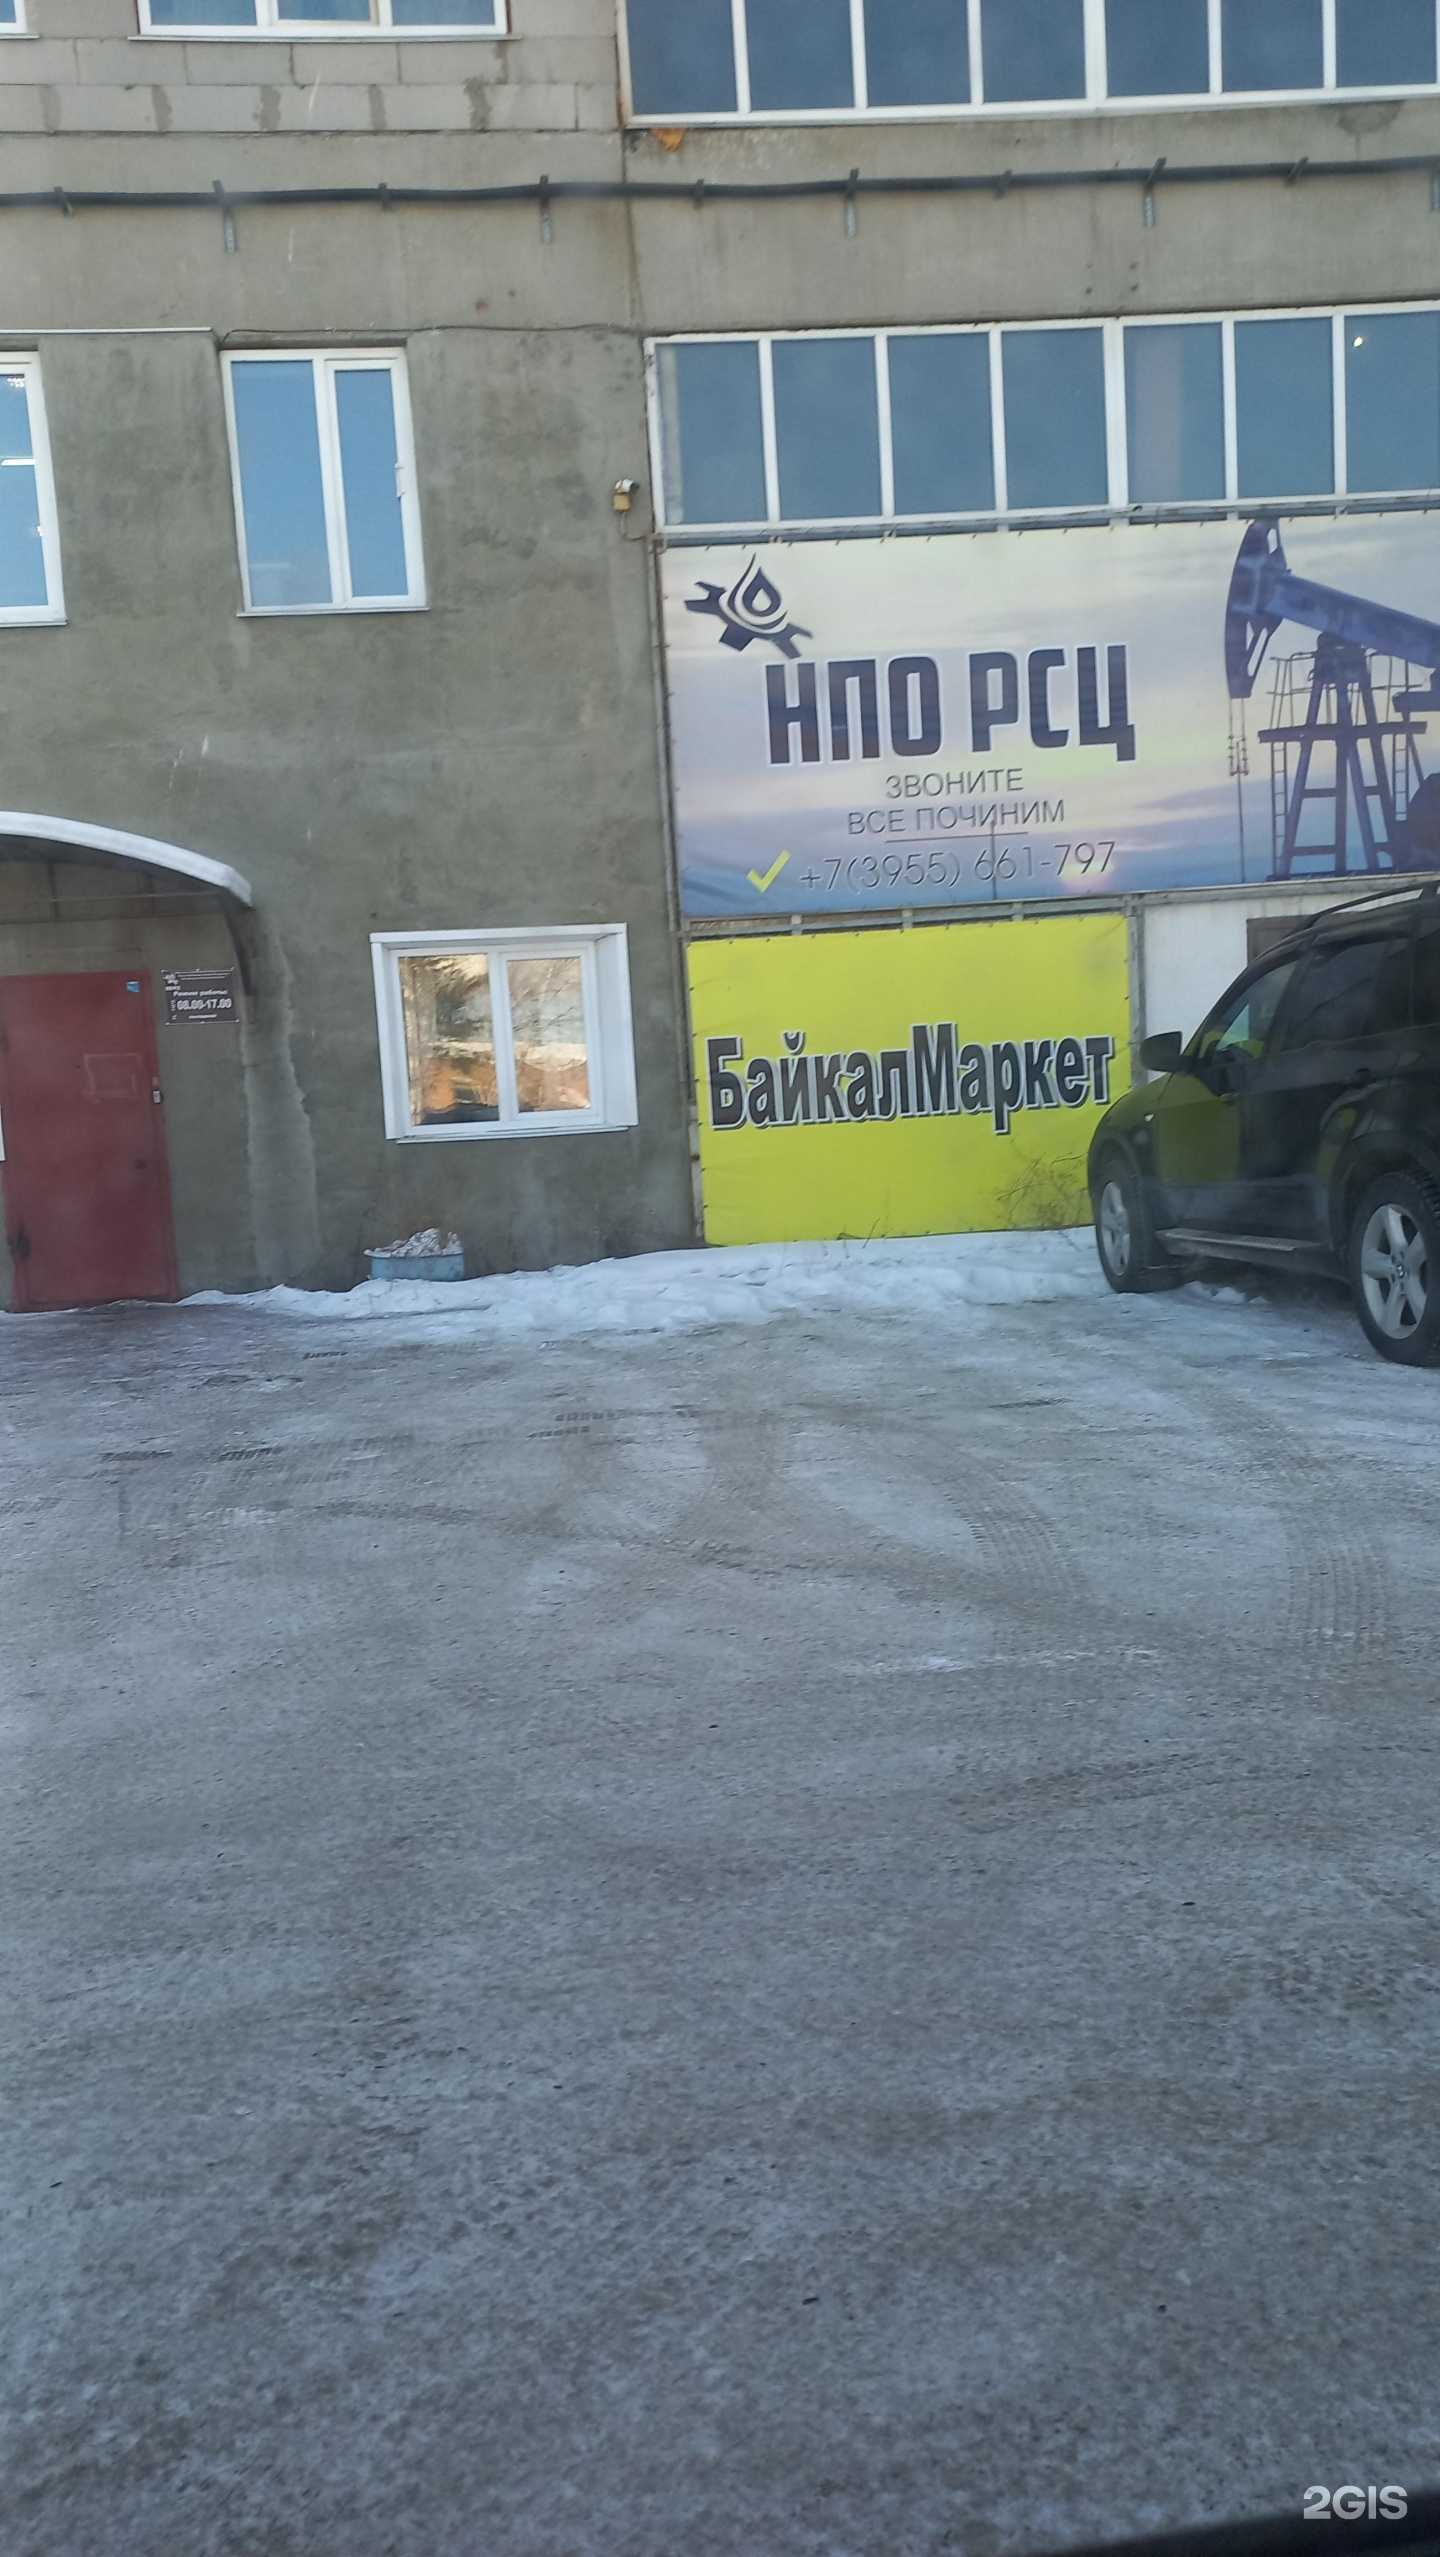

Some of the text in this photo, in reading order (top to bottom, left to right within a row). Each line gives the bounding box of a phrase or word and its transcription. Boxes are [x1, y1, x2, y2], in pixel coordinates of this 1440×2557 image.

[765, 644, 1136, 764] НПО РСЦ
[885, 768, 1024, 799] ЗВОНИТЕ
[848, 800, 1065, 835] ВСЕ ПОЧИНИМ
[801, 841, 1116, 893] +7(3955) 661-797
[706, 1022, 1114, 1134] БайкалМаркет
